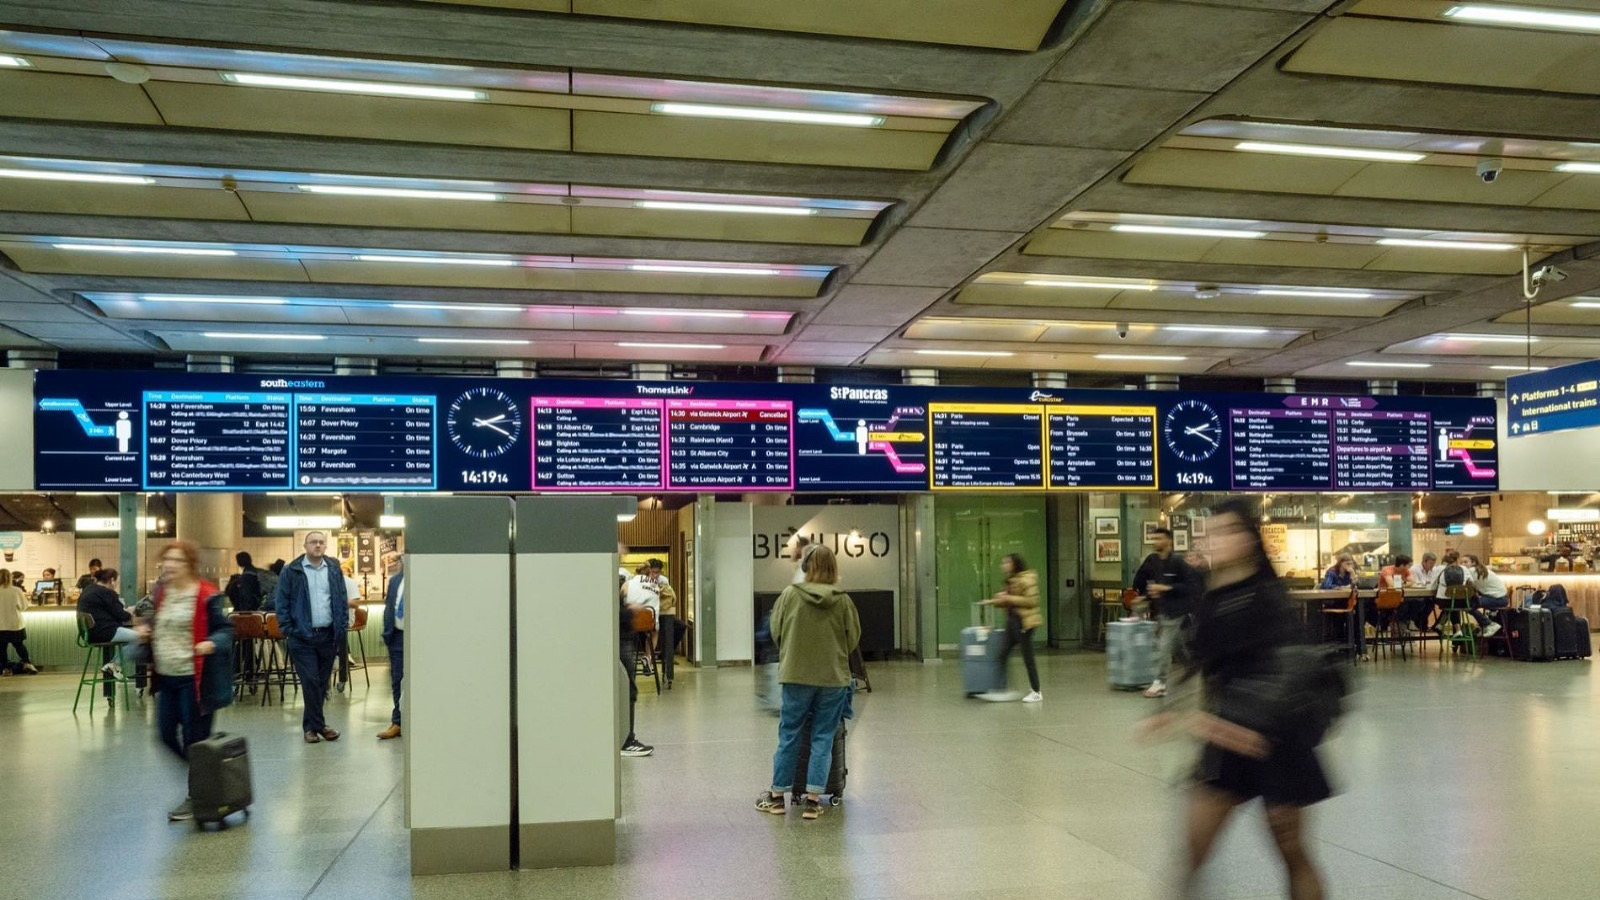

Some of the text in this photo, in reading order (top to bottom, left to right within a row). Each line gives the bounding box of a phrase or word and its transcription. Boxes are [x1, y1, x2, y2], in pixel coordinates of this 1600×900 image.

[1522, 389, 1559, 402] Platforms
[1522, 398, 1597, 416] International trains
[461, 470, 509, 483] 14:19 14
[1176, 473, 1213, 484] 14:19 14
[753, 532, 890, 559] BEUGO
